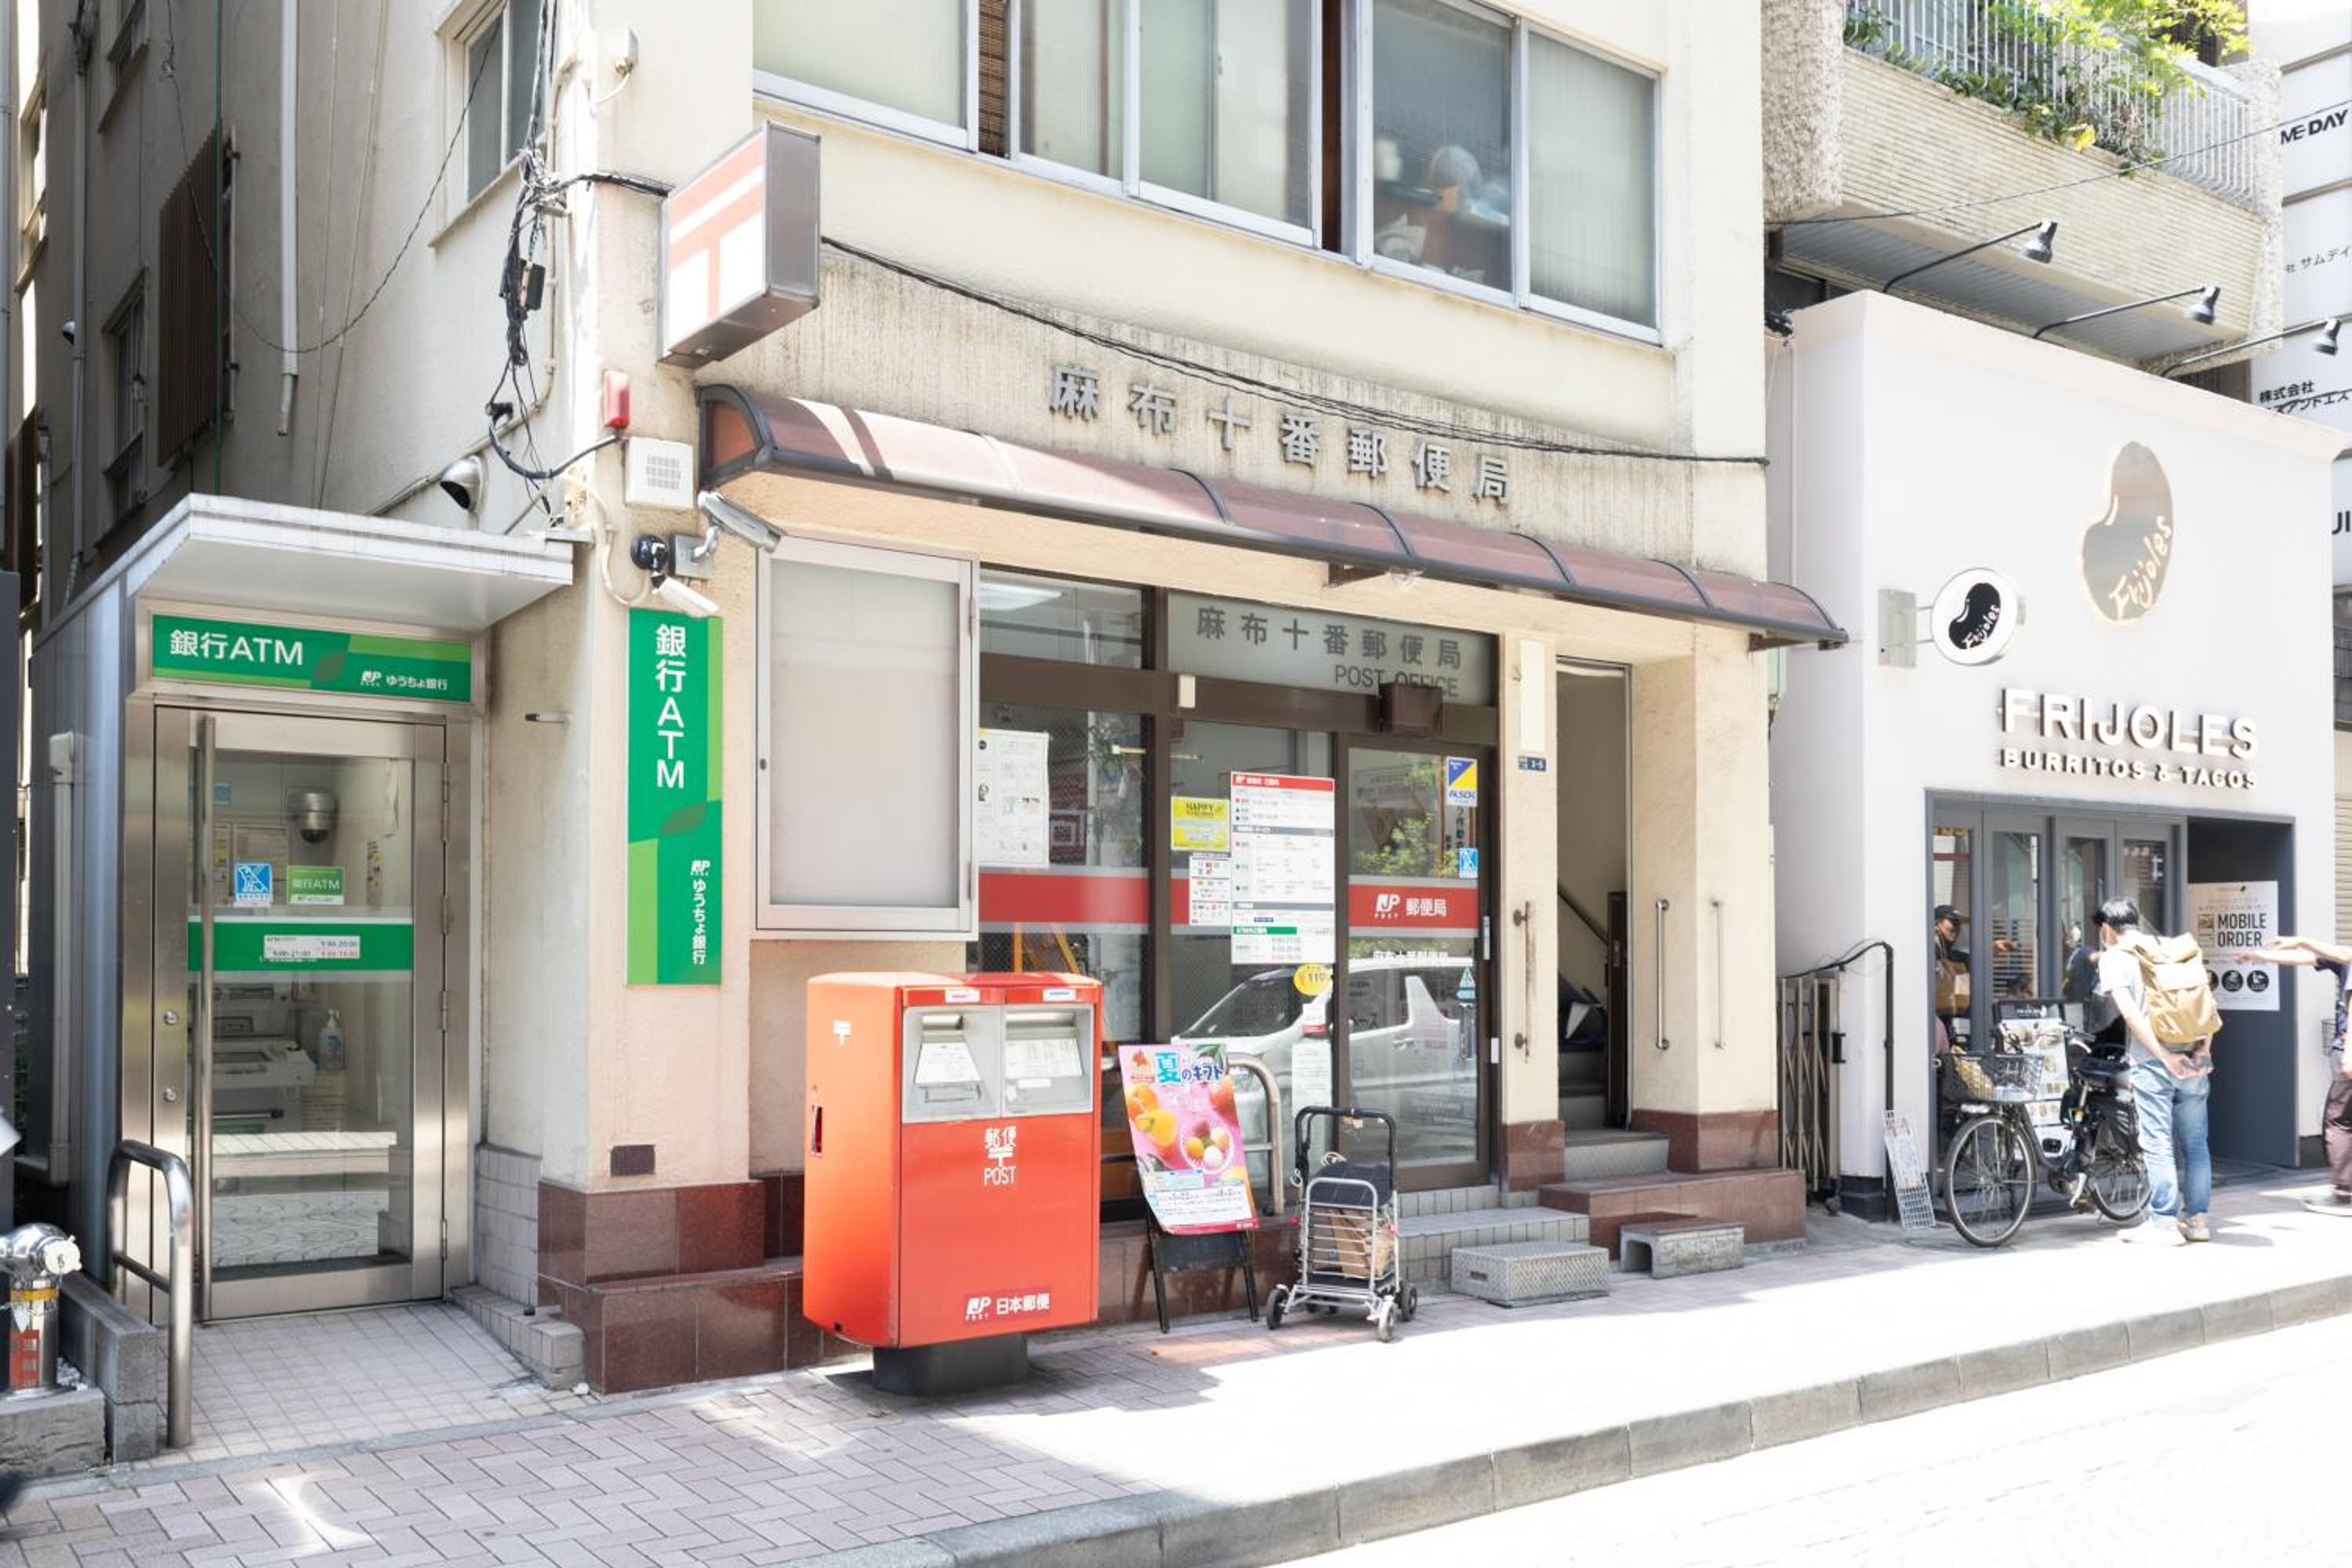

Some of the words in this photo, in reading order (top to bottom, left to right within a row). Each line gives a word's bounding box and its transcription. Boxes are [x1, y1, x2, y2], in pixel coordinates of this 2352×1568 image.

[2259, 379, 2314, 405] 株式会社
[1048, 363, 1512, 505] 麻布十番郵便局
[2108, 515, 2172, 619] Frijoles
[1196, 606, 1461, 670] 麻布十番郵便局
[1962, 604, 2000, 649] Frijoles
[169, 629, 304, 666] 銀行ATM
[386, 674, 448, 691] ゆうちょ銀行
[1334, 664, 1385, 688] POST
[655, 623, 687, 789] 銀行ATM
[2000, 688, 2258, 760] FRIJOLES
[1998, 748, 2146, 779] BURRITOS
[2154, 762, 2172, 782] &
[2180, 765, 2259, 790] TACOS
[692, 877, 707, 966] ゆうちょ銀行
[1406, 898, 1447, 916] 郵便局
[2217, 913, 2267, 929] MOBILE
[2217, 931, 2263, 948] ORDER
[984, 1125, 1017, 1149] 郵便
[984, 1166, 1018, 1185] POST
[996, 1292, 1051, 1315] 日本郵便
